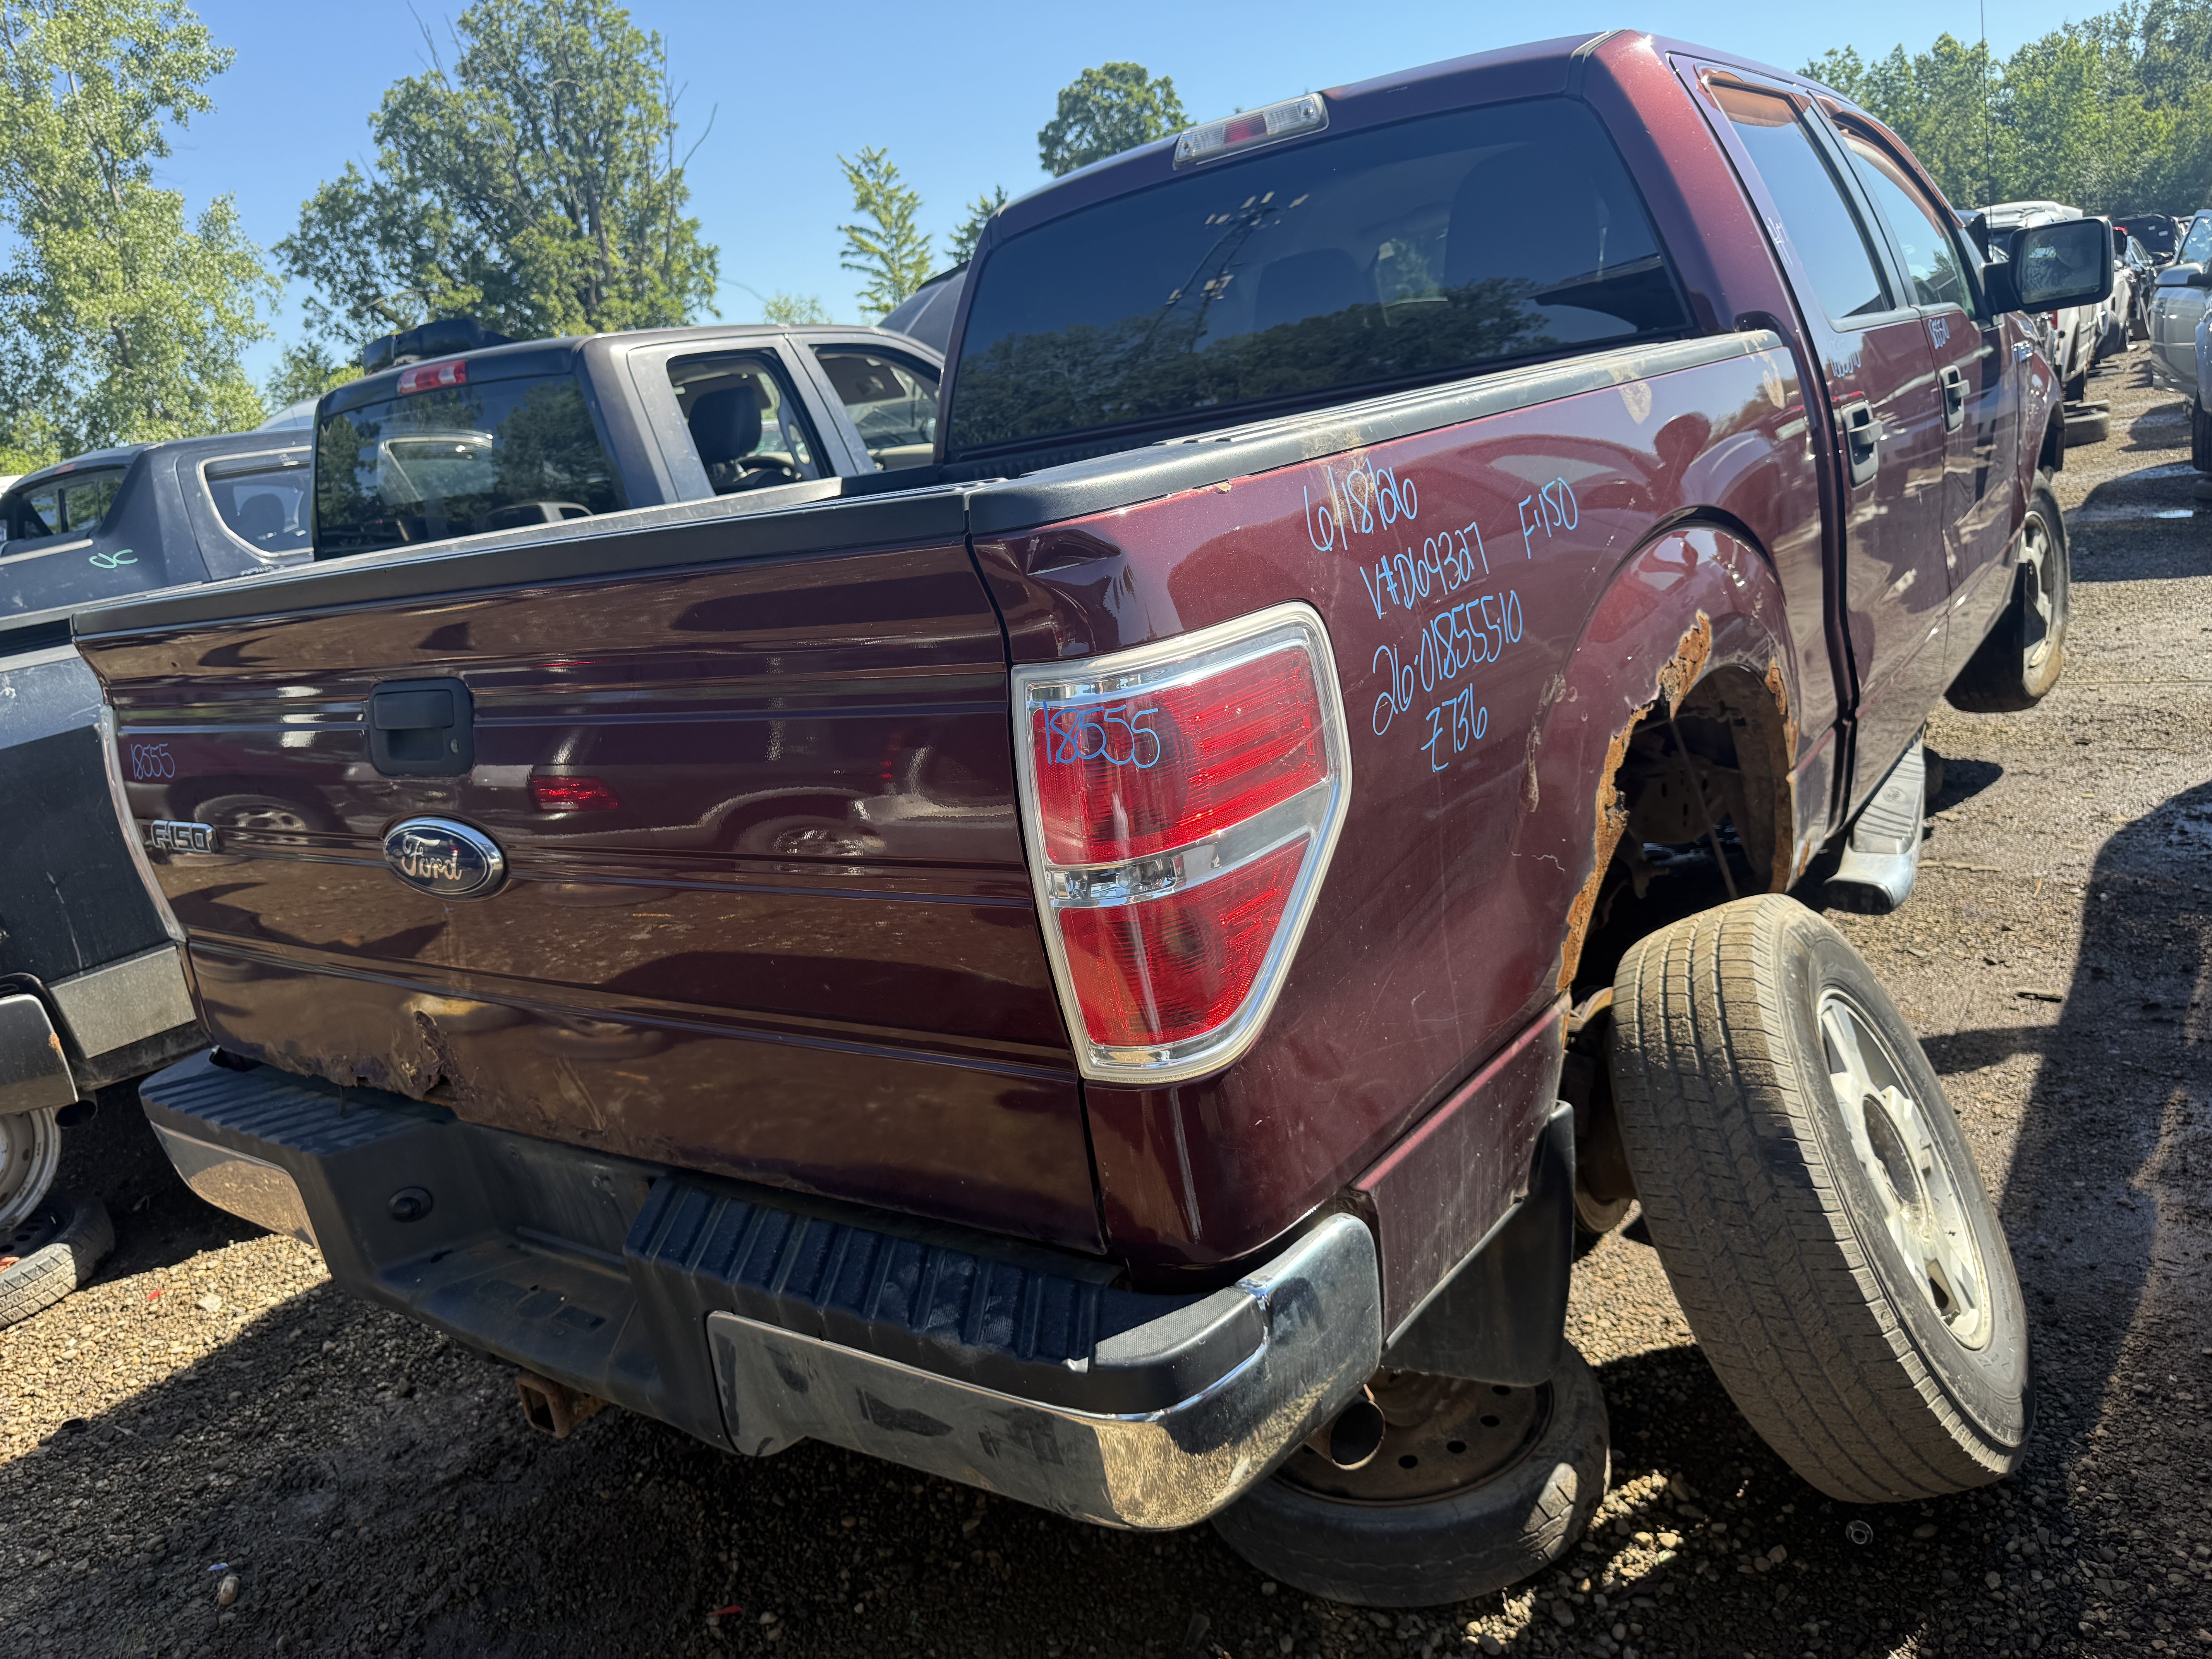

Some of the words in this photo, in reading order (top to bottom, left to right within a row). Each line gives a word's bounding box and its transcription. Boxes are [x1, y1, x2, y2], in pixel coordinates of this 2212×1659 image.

[1043, 700, 1161, 769] 18555
[130, 743, 175, 780] 18555
[401, 833, 462, 881] Ford
